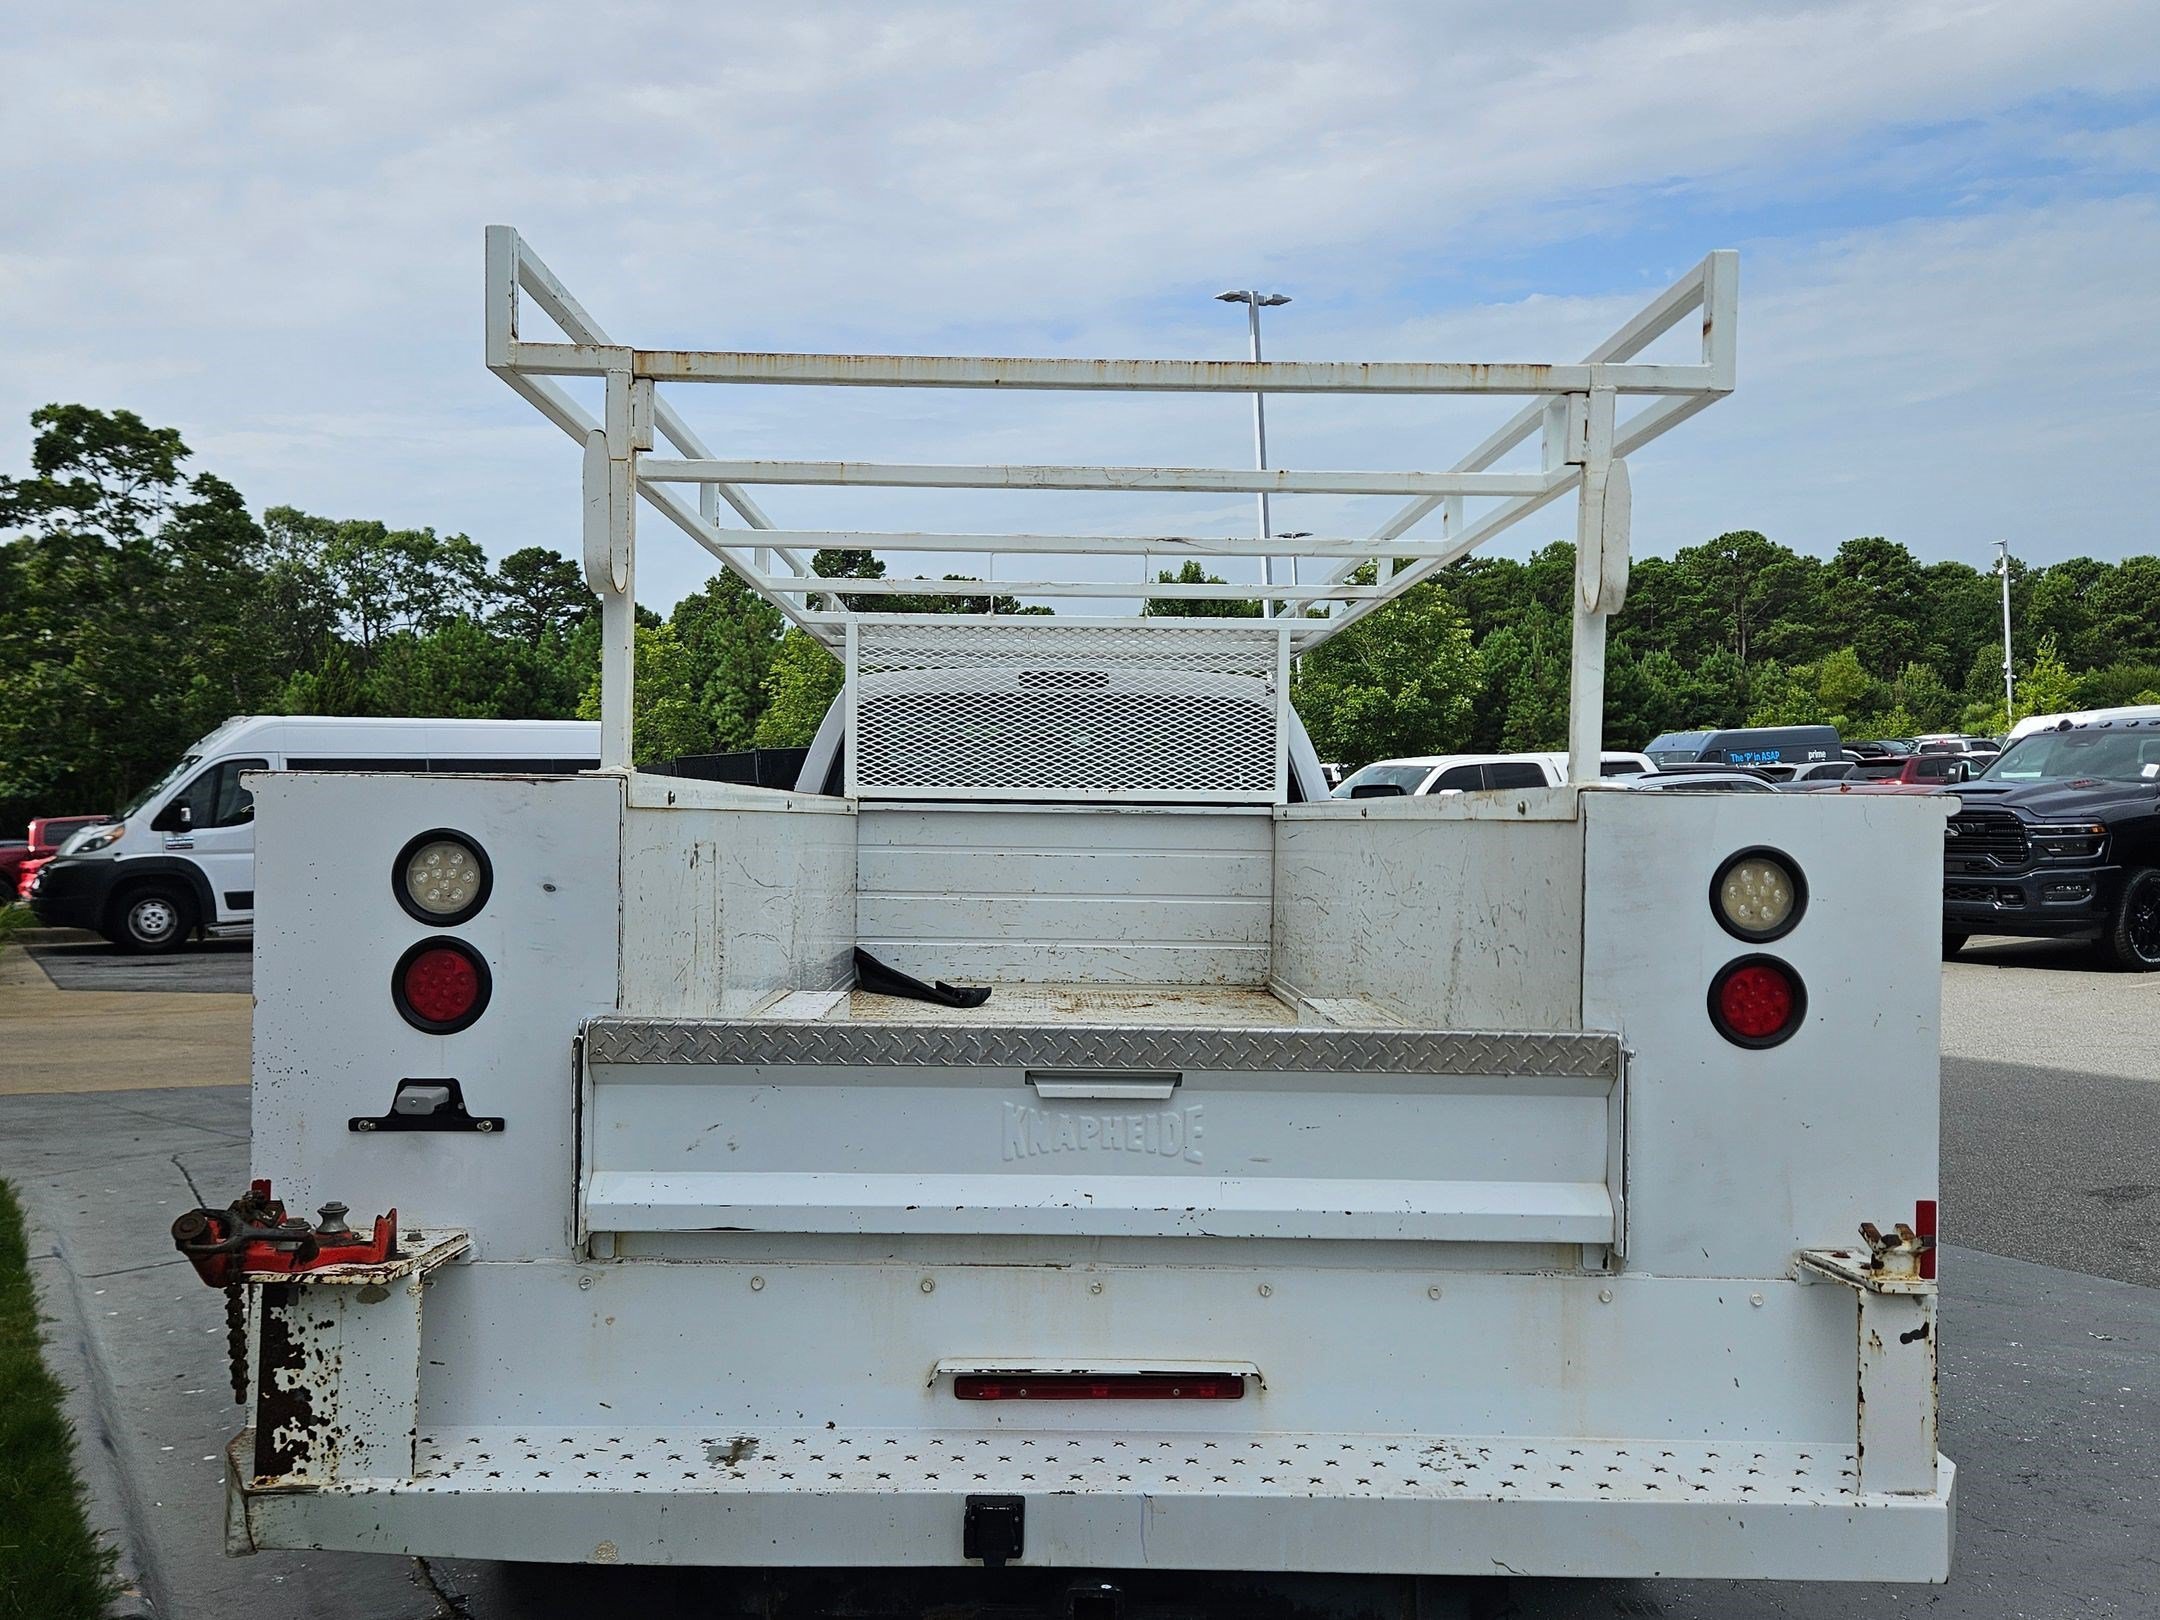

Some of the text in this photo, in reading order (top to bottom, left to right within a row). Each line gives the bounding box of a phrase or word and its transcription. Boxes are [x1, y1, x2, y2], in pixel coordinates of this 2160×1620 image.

[1730, 753, 1744, 762] The
[1761, 751, 1780, 760] ASAP
[1808, 750, 1827, 760] prime
[1002, 1101, 1203, 1164] KNAPHEIDE
